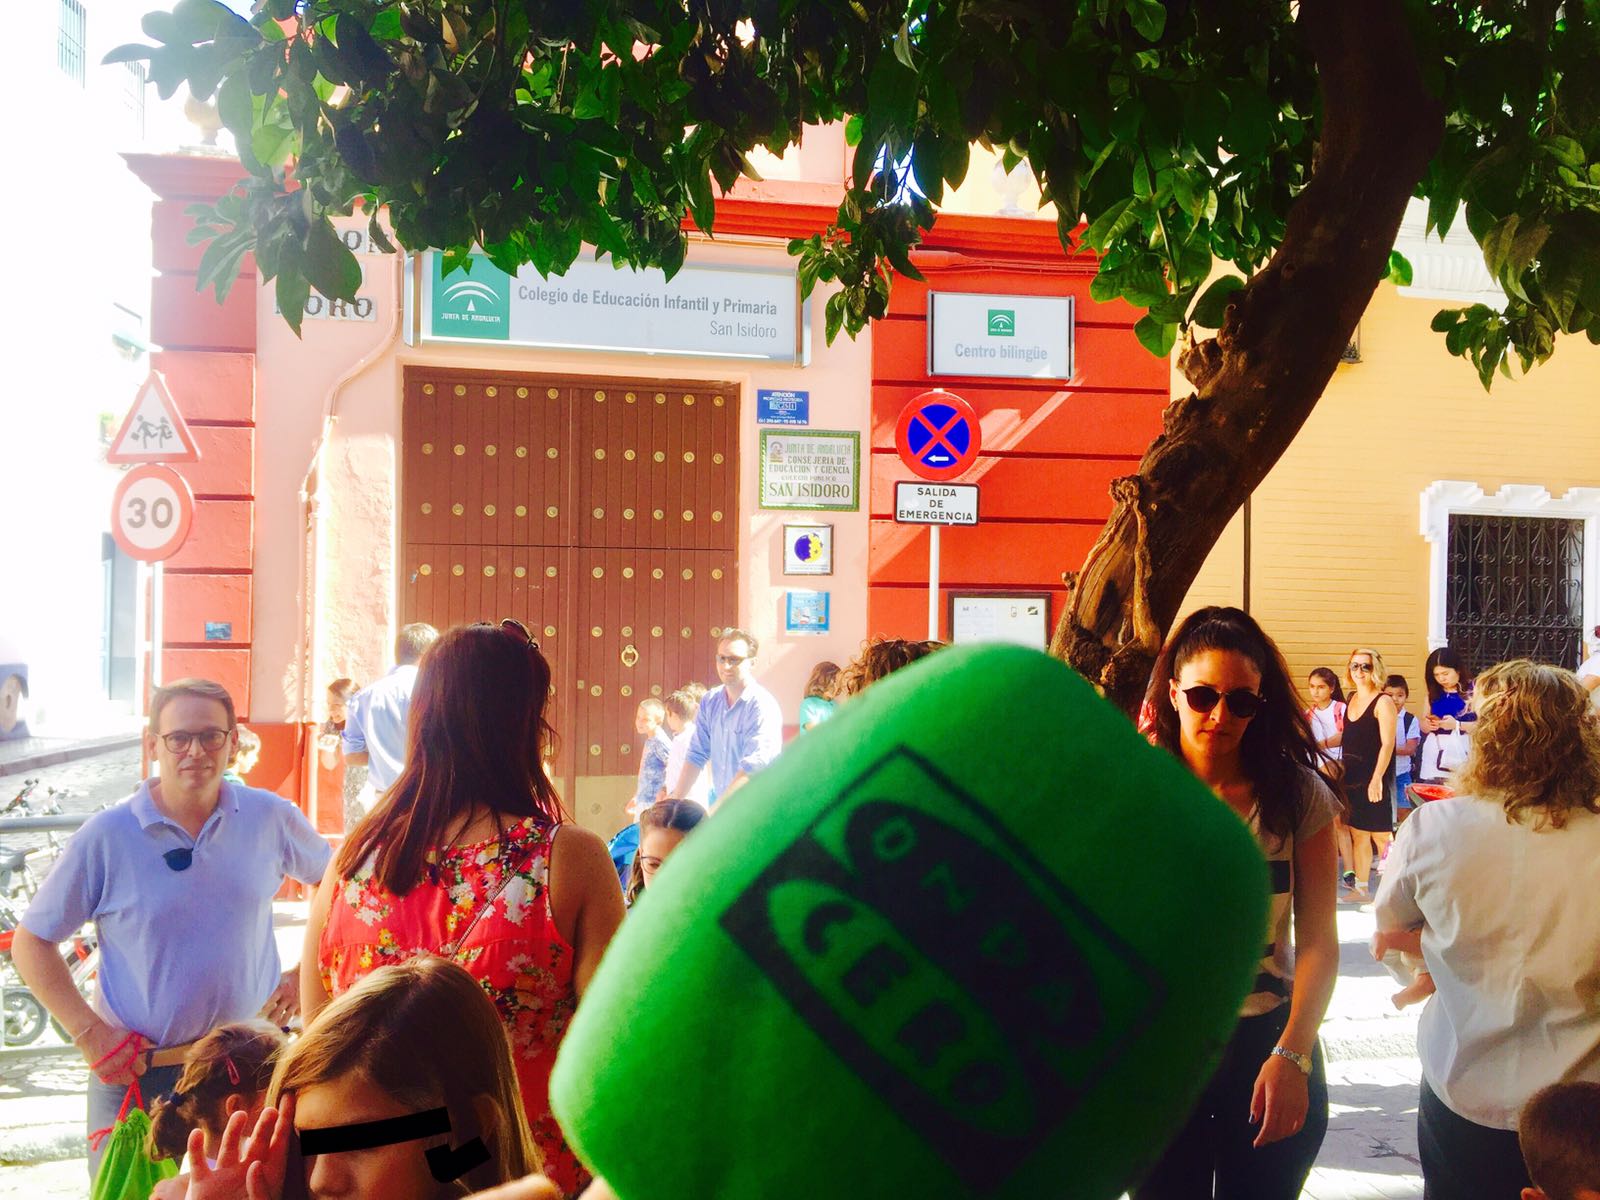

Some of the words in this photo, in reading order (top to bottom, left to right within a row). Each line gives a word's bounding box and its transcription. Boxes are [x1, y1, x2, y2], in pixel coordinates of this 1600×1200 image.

[275, 294, 373, 318] ORO
[518, 285, 569, 306] Colegio
[572, 288, 588, 304] de
[592, 289, 660, 309] Educación
[664, 294, 709, 312] Infantil
[711, 299, 720, 315] y
[723, 298, 777, 316] Primaria
[441, 312, 460, 321] JUNTA
[710, 321, 733, 336] San
[737, 321, 777, 338] Isidoro
[954, 343, 996, 359] Centro
[1000, 345, 1048, 363] bilingüe
[785, 443, 805, 455] JUNTA
[807, 443, 815, 455] DE
[836, 456, 847, 466] DE
[814, 465, 819, 474] Y
[820, 465, 850, 475] CIENCIA
[768, 482, 793, 498] SAN
[798, 483, 850, 498] ISIDORO
[917, 487, 957, 498] SALIDA
[929, 499, 944, 508] DE
[127, 497, 174, 529] 30
[899, 510, 973, 521] EMERGENCIA
[869, 814, 1078, 1036] ONDA
[802, 900, 1006, 1106] CERO
